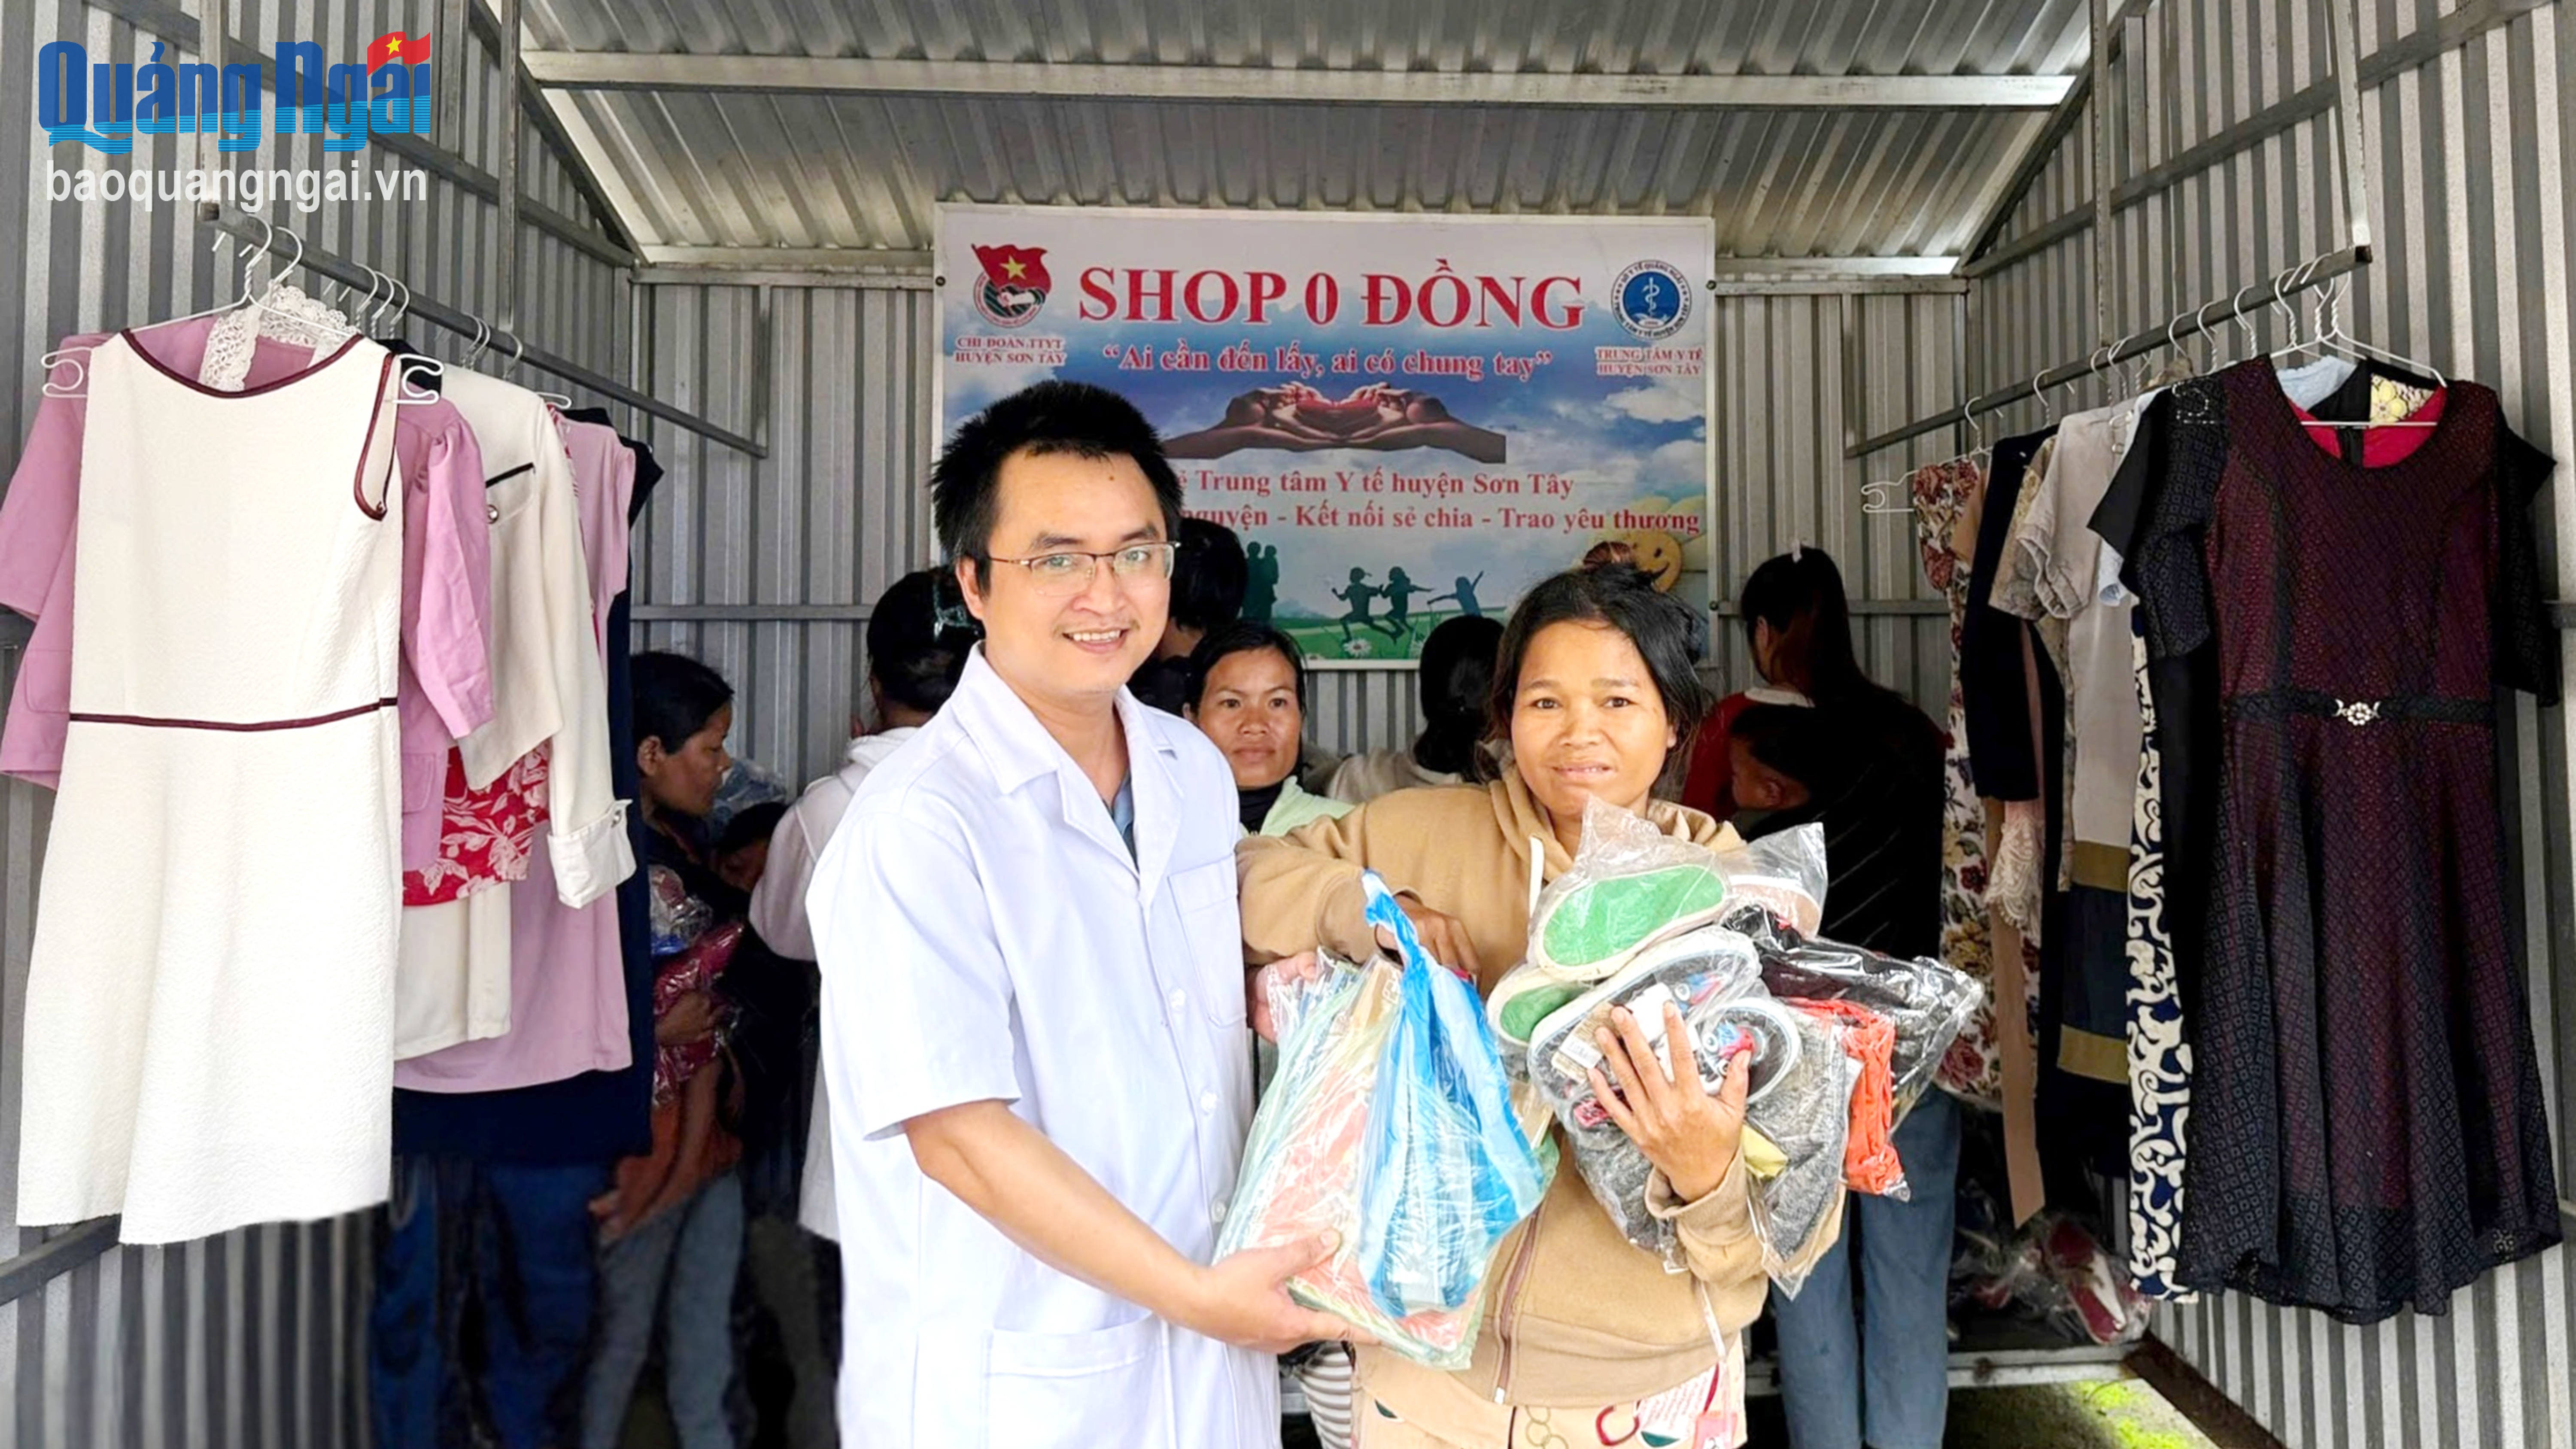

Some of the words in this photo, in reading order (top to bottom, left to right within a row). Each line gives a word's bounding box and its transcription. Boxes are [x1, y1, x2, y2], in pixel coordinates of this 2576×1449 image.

[1079, 267, 1287, 323] SHOP
[1304, 272, 1339, 325] 0
[1360, 258, 1585, 329] ĐỒNG
[957, 337, 982, 347] CHI
[1030, 338, 1064, 349] TTYT
[1598, 349, 1640, 360] TRUNG
[1646, 347, 1672, 360] TÂM
[1676, 350, 1685, 360] Y
[1688, 347, 1704, 360] TẾ
[955, 351, 1002, 364] HUYỆN
[1007, 352, 1034, 363] SƠN
[1039, 351, 1065, 364] TÂY
[1162, 339, 1209, 371] cần
[1218, 340, 1268, 371] đến
[1276, 340, 1324, 377] lấy,
[1332, 349, 1357, 373] ai
[1365, 349, 1394, 374] có
[1403, 349, 1483, 380] chung
[1599, 364, 1642, 375] HUYỆN
[1646, 364, 1672, 374] SƠN
[1677, 363, 1701, 374] TÂY
[1195, 470, 1271, 497] Trung
[1280, 471, 1327, 492] tâm
[1335, 471, 1355, 492] Y
[1363, 466, 1384, 492] tế
[1391, 472, 1464, 498] huyện
[1473, 473, 1520, 494] Sơn
[1527, 473, 1574, 500] Tây
[1296, 499, 1339, 527] Kết
[1348, 500, 1384, 527] nối
[1393, 506, 1416, 527] sẻ
[1425, 507, 1473, 528] chia
[1498, 507, 1555, 529] Trao
[1564, 508, 1605, 534] yêu
[1613, 508, 1700, 534] thương
